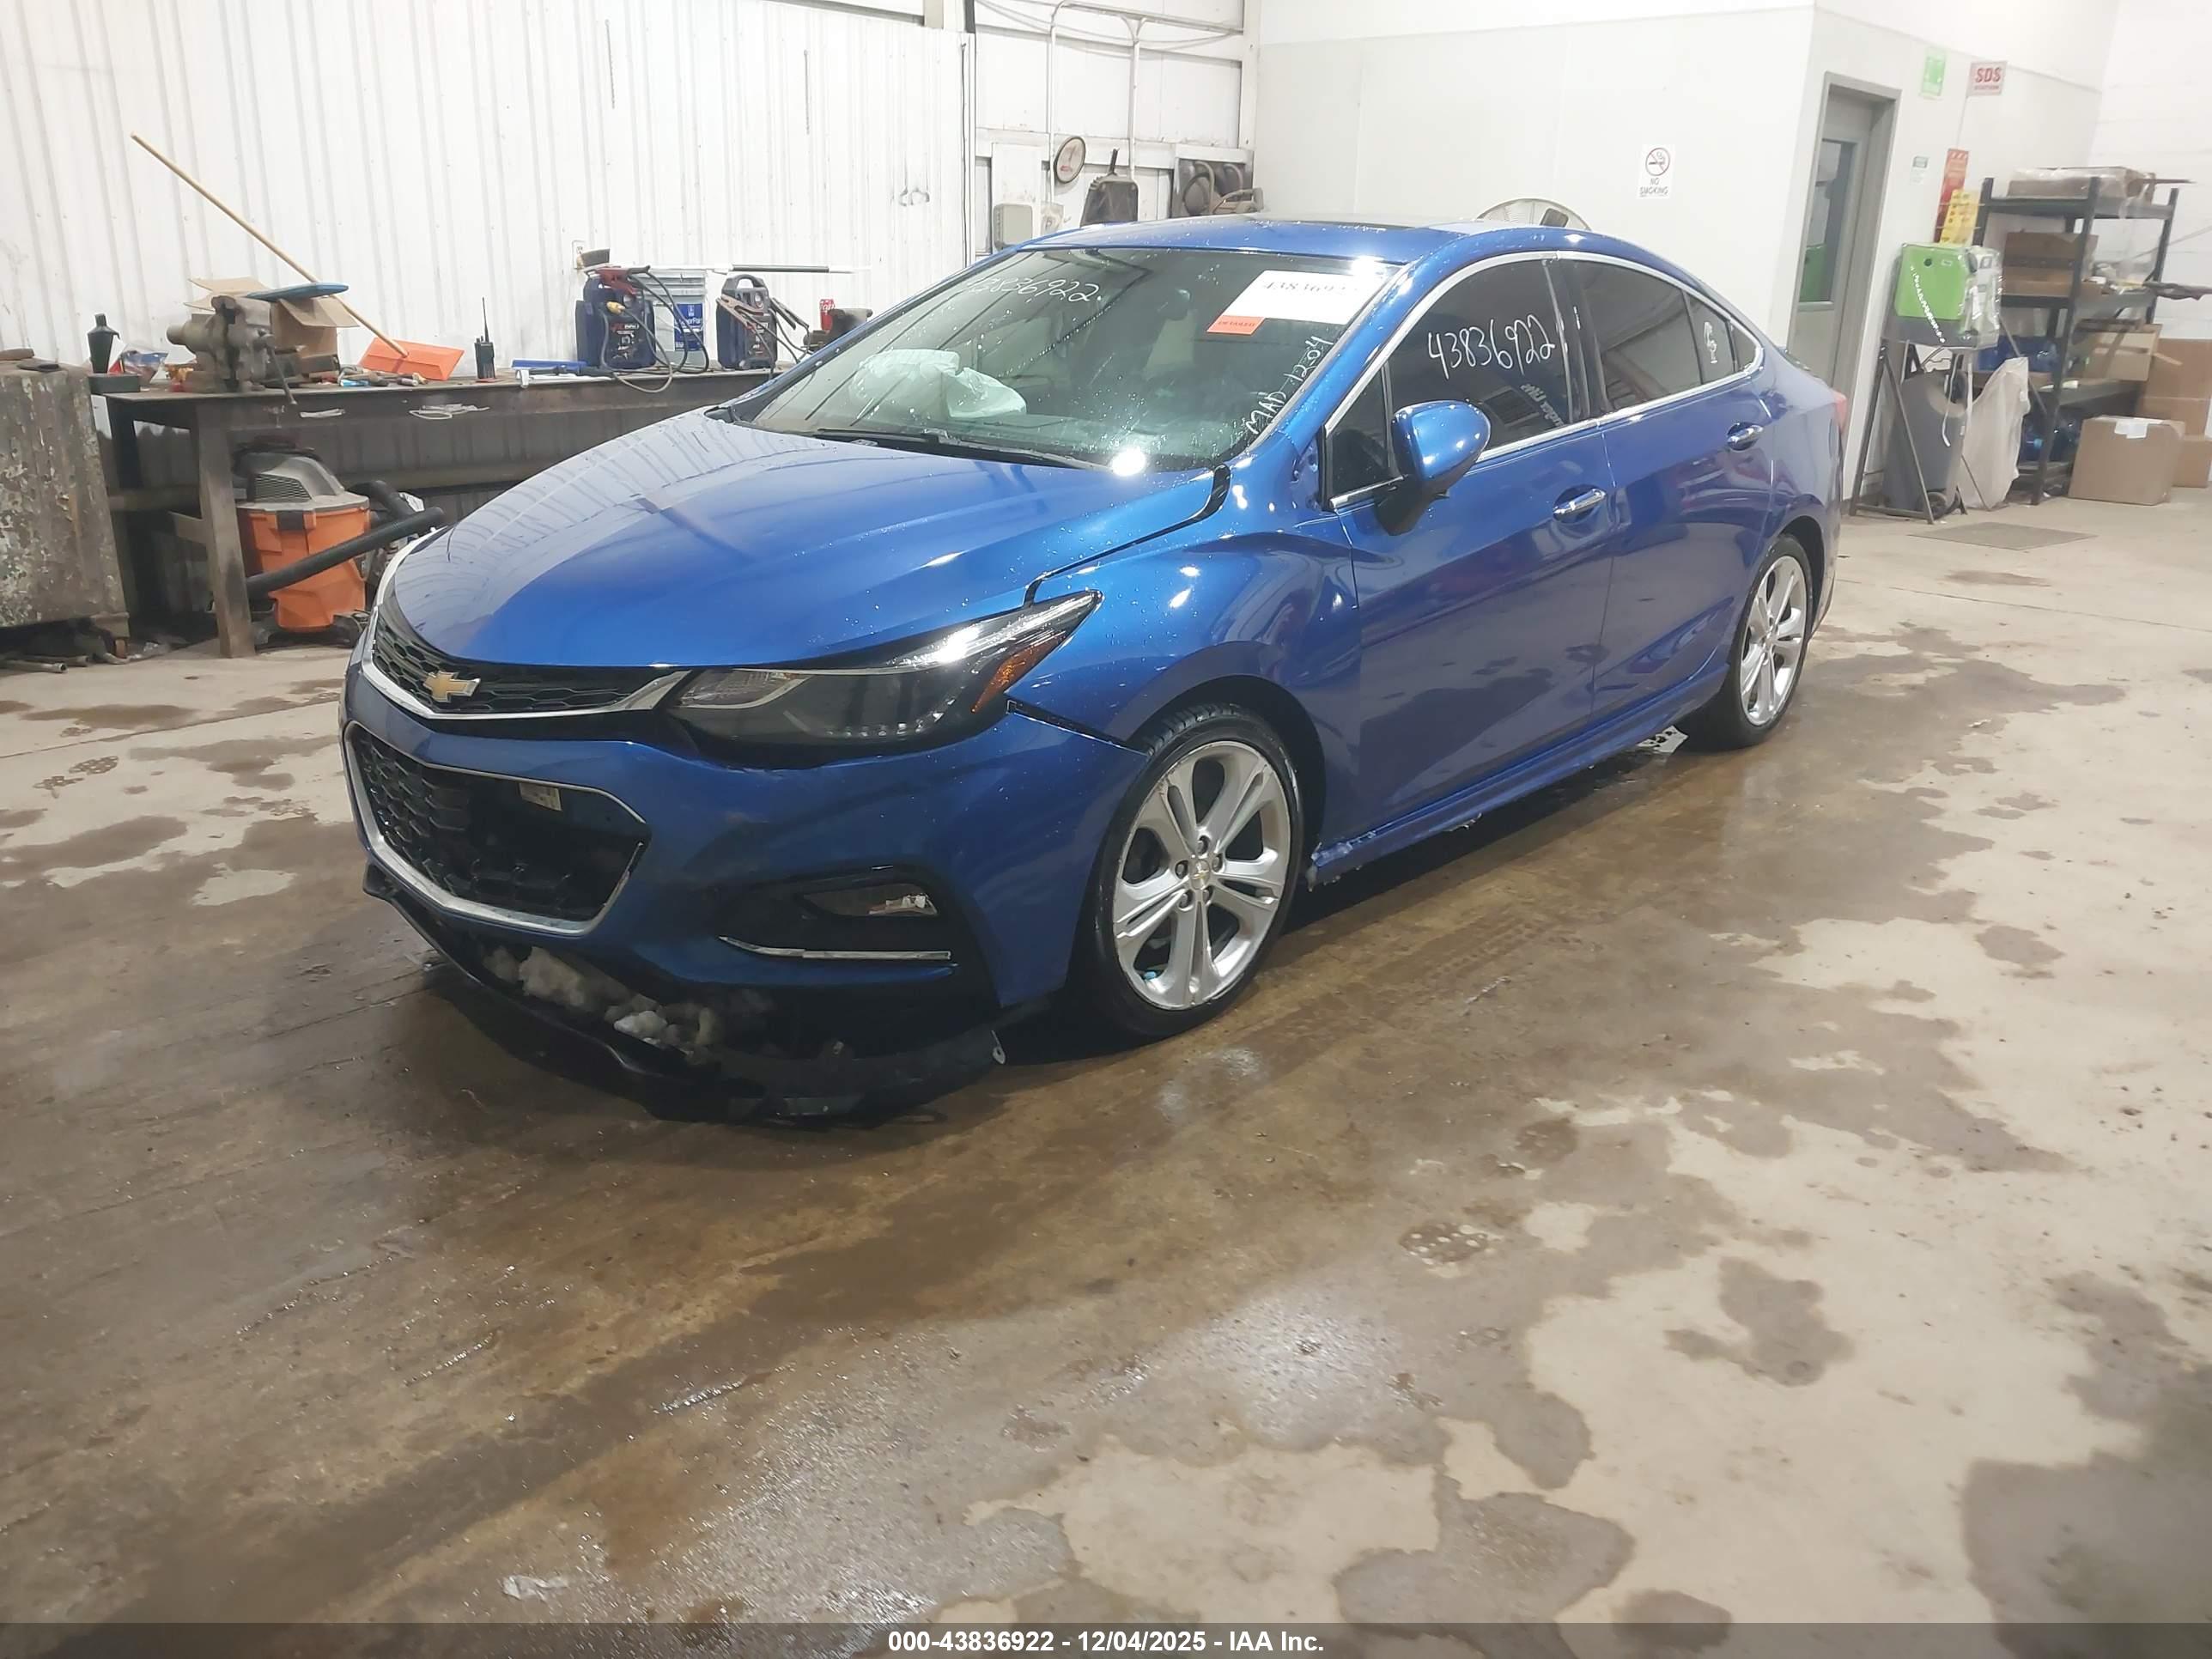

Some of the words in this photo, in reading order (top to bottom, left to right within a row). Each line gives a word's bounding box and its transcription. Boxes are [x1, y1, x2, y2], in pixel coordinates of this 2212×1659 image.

[1975, 67, 2002, 83] SDS
[1650, 177, 1660, 185] NO
[1428, 314, 1556, 380] 43836922
